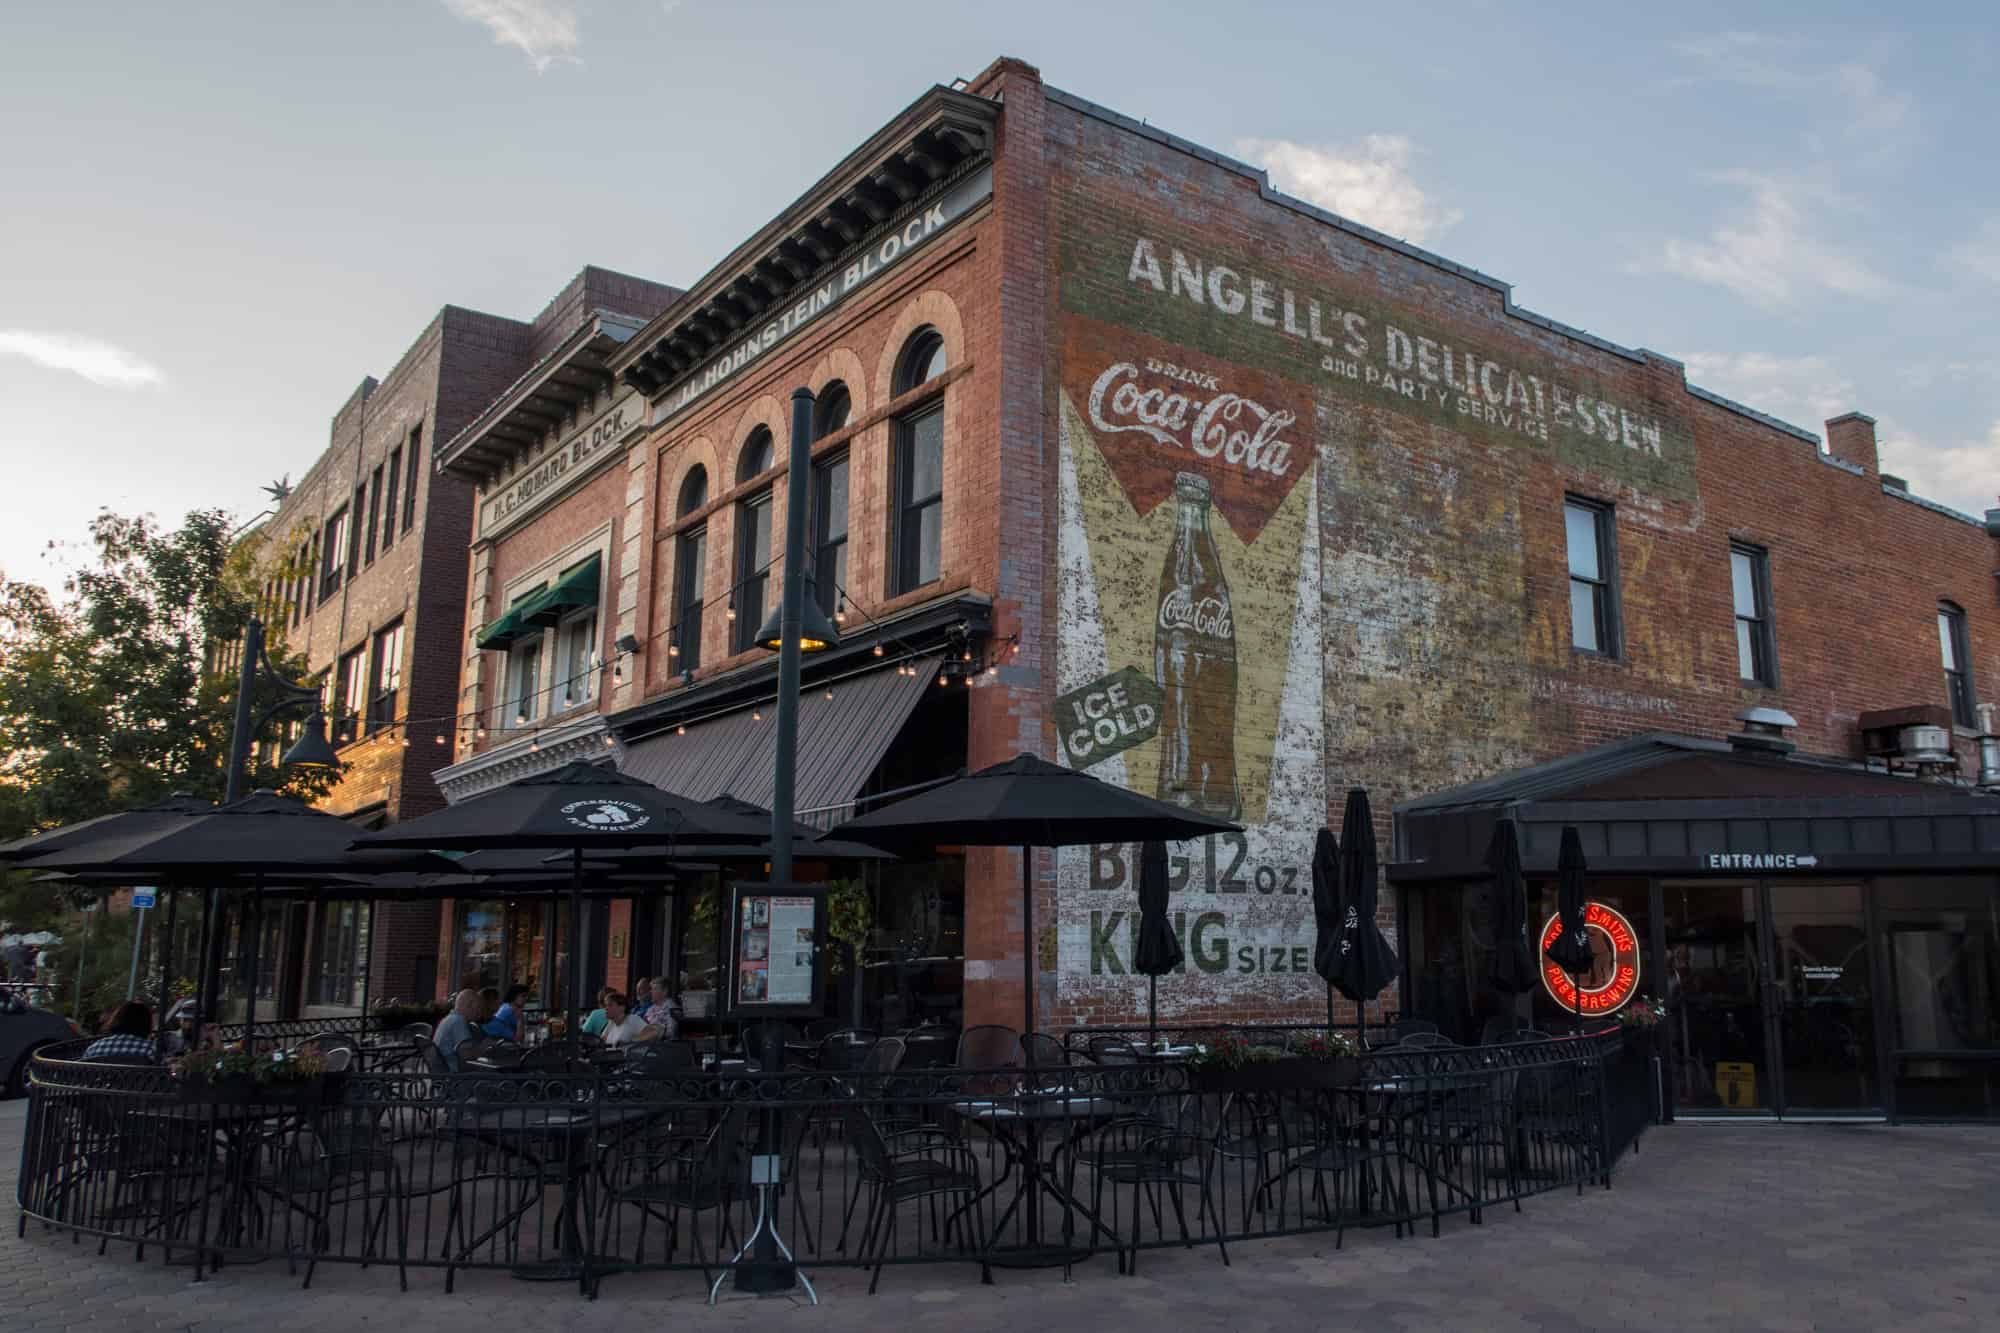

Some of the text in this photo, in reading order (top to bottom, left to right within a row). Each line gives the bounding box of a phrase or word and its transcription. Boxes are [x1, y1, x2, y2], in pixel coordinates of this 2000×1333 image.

[844, 202, 944, 292] BLOCK
[1128, 238, 1662, 457] ANGELL'S DELICATESSEN
[1146, 358, 1222, 391] DRINK
[1321, 355, 1549, 440] and PARTY SERVICE
[518, 453, 568, 503] HOWARD
[573, 409, 628, 463] BLOCK.
[1068, 703, 1155, 757] COLD
[1073, 682, 1129, 725] ICE
[1205, 832, 1249, 894] 12
[1710, 854, 1796, 868] ENTRANCE
[1238, 946, 1308, 974] SIZE
[1548, 967, 1569, 995] PUB
[1580, 967, 1634, 1008] BREWING
